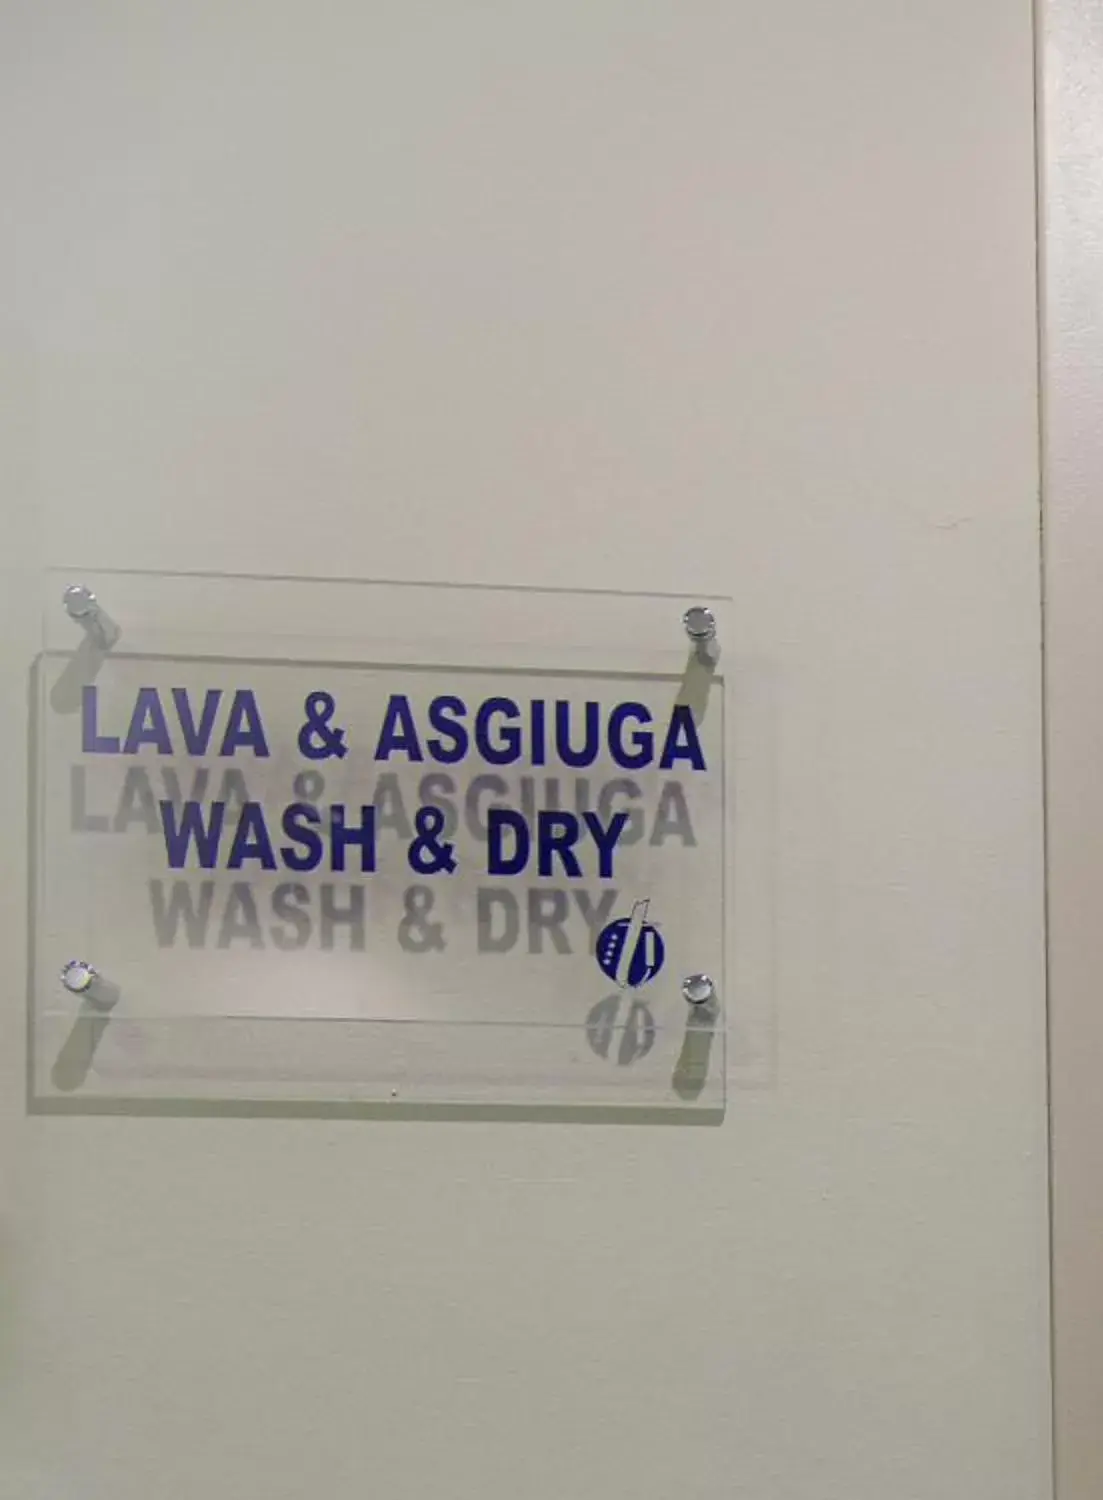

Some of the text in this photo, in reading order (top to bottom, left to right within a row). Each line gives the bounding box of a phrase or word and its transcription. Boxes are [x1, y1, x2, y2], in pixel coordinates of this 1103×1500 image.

[81, 685, 707, 773] LAVA & ASGIUGA
[160, 801, 630, 880] WASH & DRY
